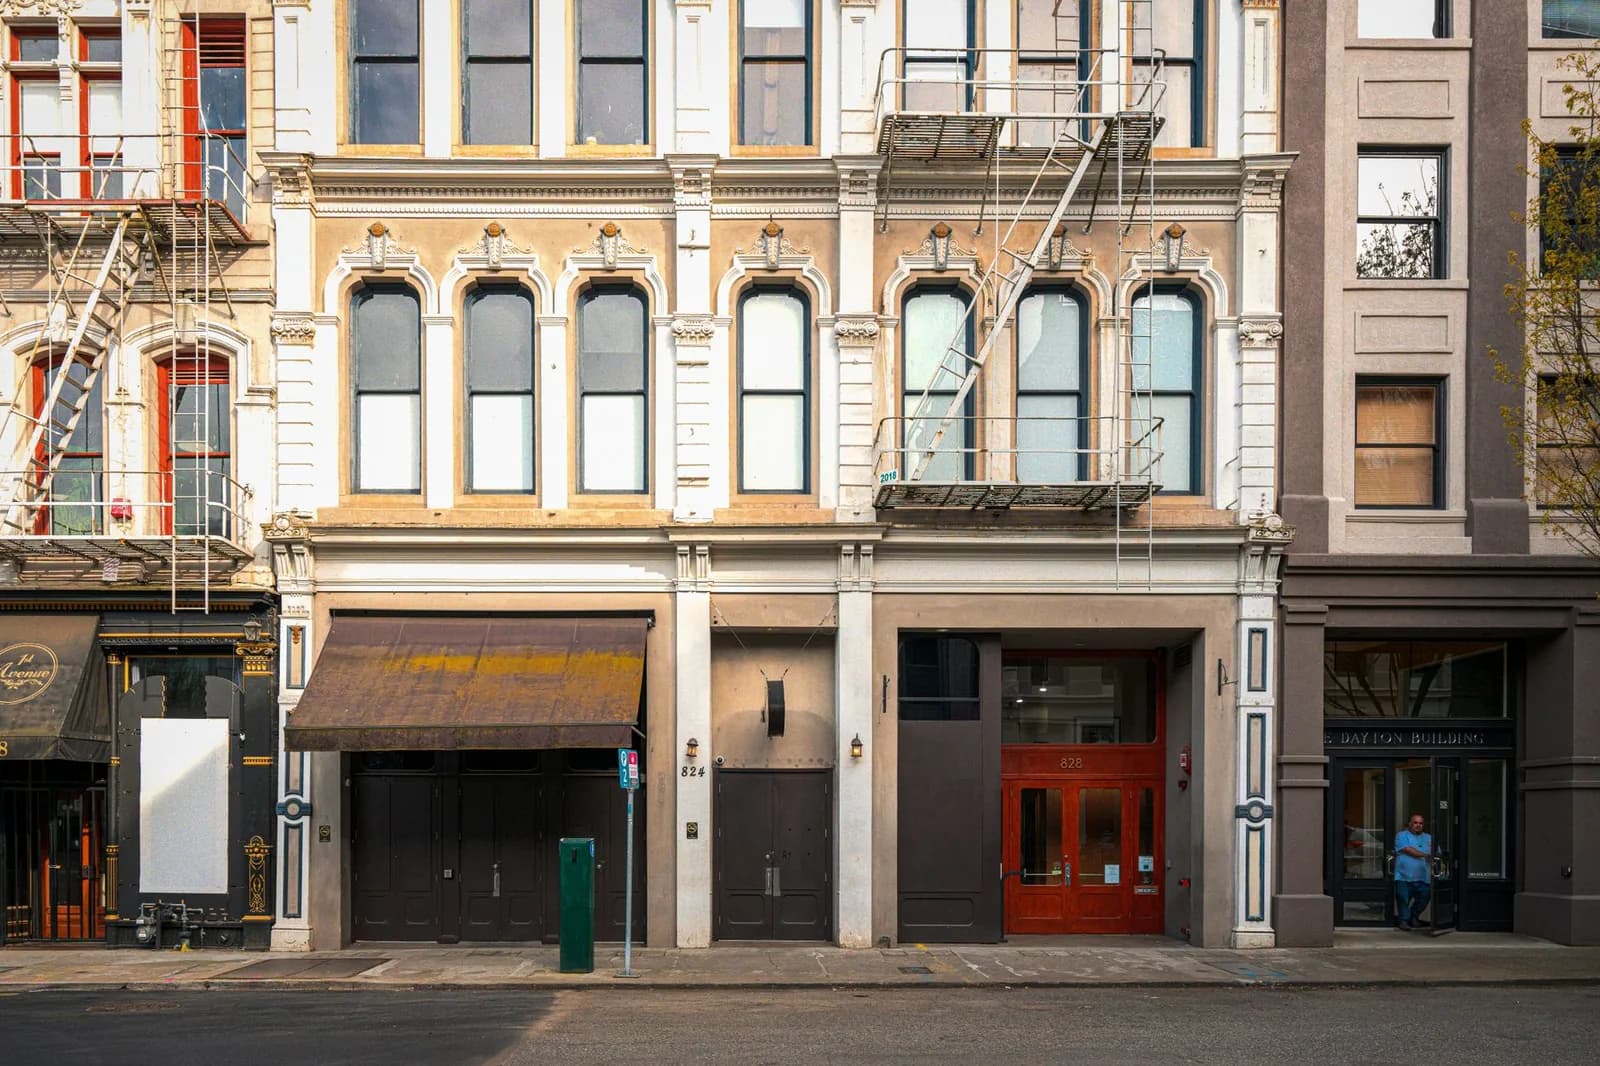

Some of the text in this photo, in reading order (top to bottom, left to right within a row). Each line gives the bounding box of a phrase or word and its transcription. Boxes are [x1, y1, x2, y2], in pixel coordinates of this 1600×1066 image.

[0, 662, 50, 678] Avenue
[1411, 731, 1485, 745] BUILDING
[1060, 758, 1082, 769] 828
[681, 766, 705, 777] 824
